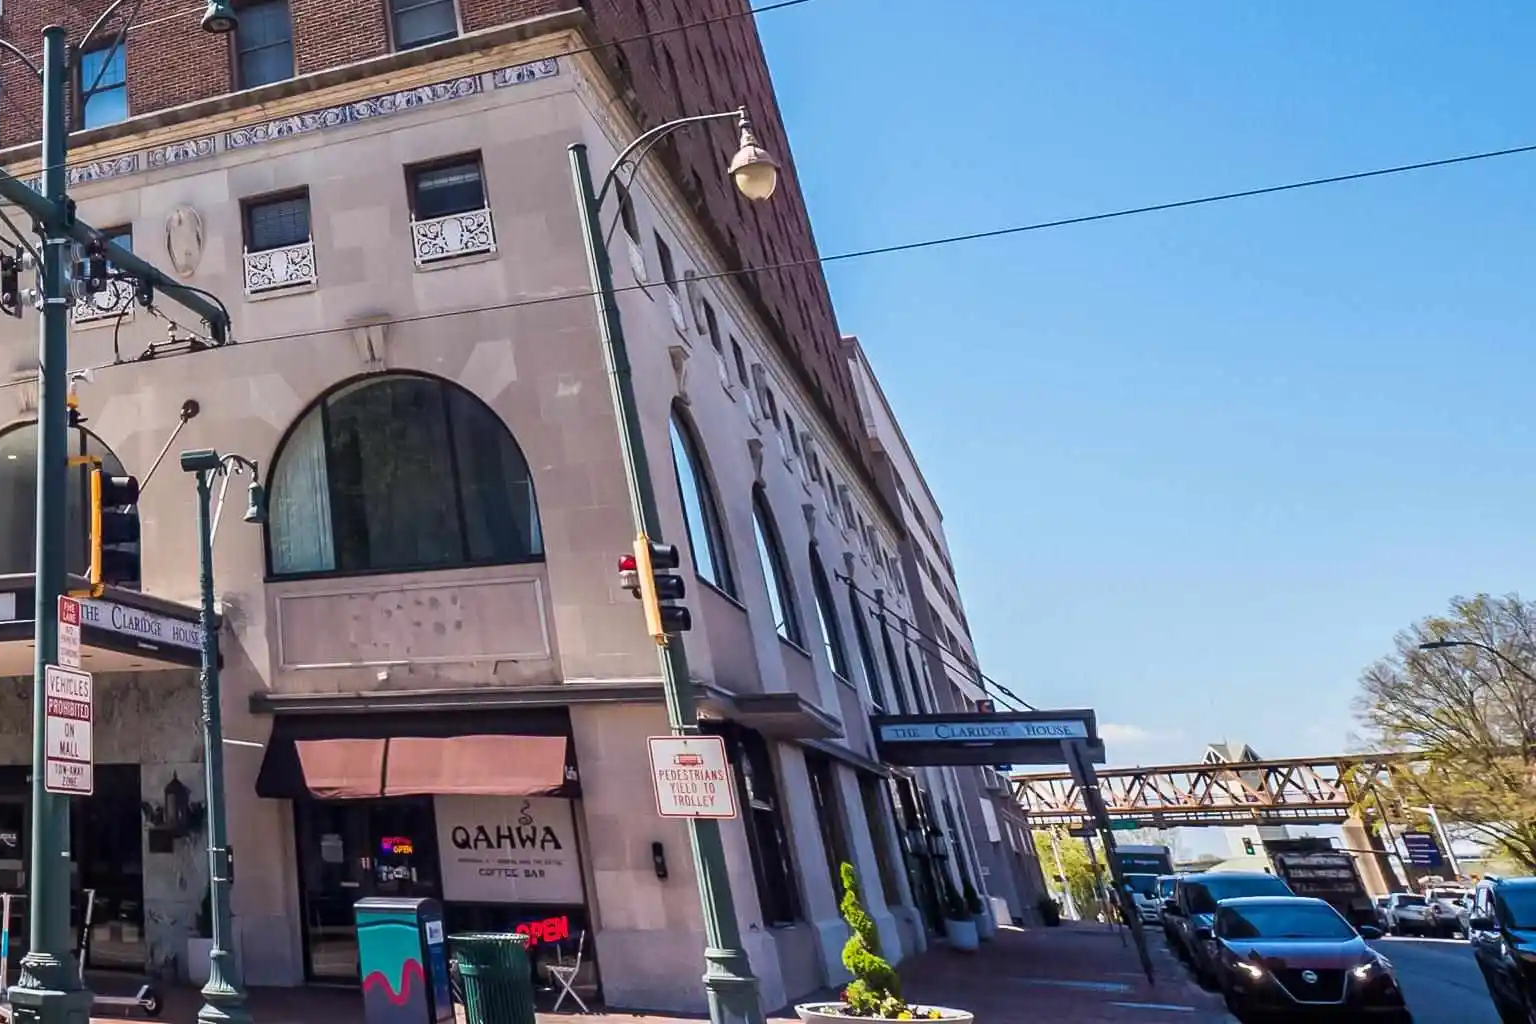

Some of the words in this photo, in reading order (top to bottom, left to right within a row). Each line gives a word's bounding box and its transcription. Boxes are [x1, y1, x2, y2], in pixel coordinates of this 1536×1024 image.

[81, 604, 99, 621] THE
[112, 606, 161, 636] CLARIDGE
[172, 626, 200, 645] HOUSE
[50, 676, 89, 698] VEHICLES
[48, 697, 89, 719] PROHIBITED
[64, 723, 75, 738] ON
[893, 728, 920, 738] THE
[935, 724, 1010, 739] CLARIDGE
[1025, 725, 1073, 737] HOUSE
[59, 741, 80, 757] MALL
[658, 769, 724, 781] PEDESTRIANS
[670, 782, 697, 794] YIELD
[703, 782, 716, 794] TO
[674, 795, 715, 807] TROLLEY
[452, 825, 562, 851] QAHWA
[478, 868, 519, 878] COFFEE
[524, 868, 546, 878] BAR
[516, 916, 568, 950] OPEN
